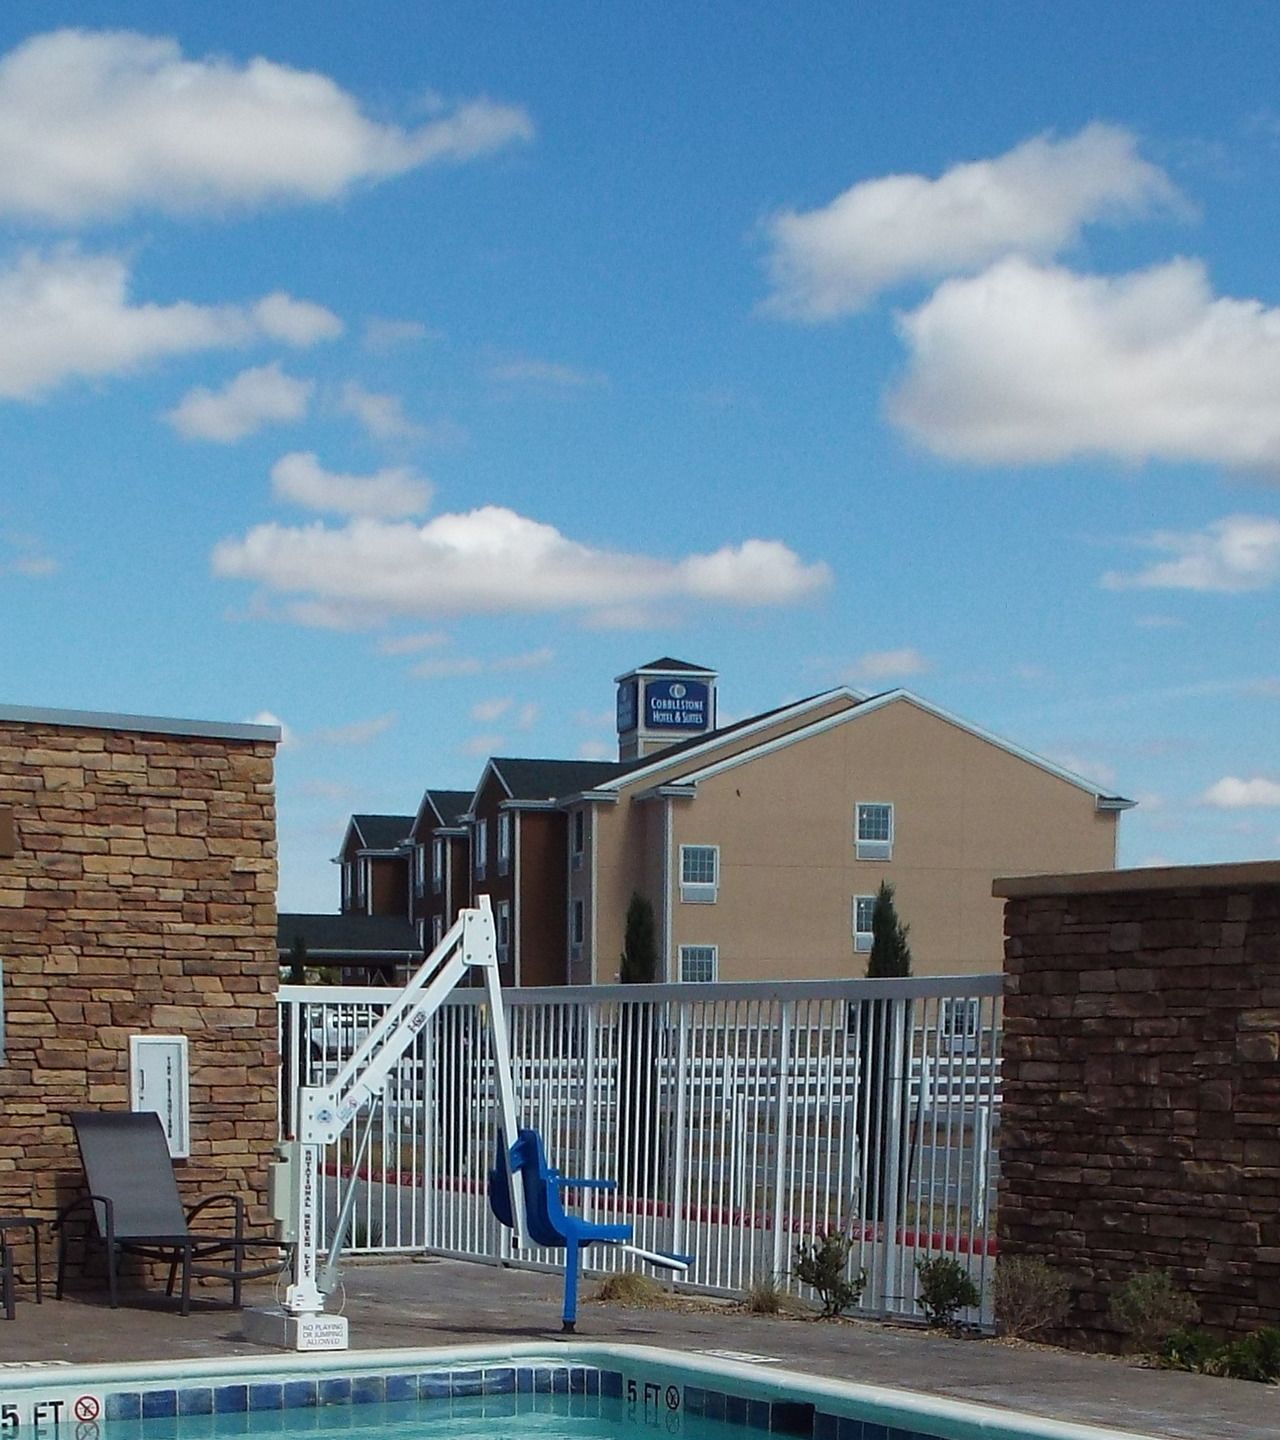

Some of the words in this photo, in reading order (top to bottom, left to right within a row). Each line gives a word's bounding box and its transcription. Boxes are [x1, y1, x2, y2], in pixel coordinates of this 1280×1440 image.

[674, 711, 681, 722] &
[304, 1150, 312, 1208] ROTATIONAL
[628, 1379, 637, 1402] 5
[645, 1382, 661, 1408] FT
[1, 1404, 19, 1427] 5
[34, 1400, 64, 1426] FT
